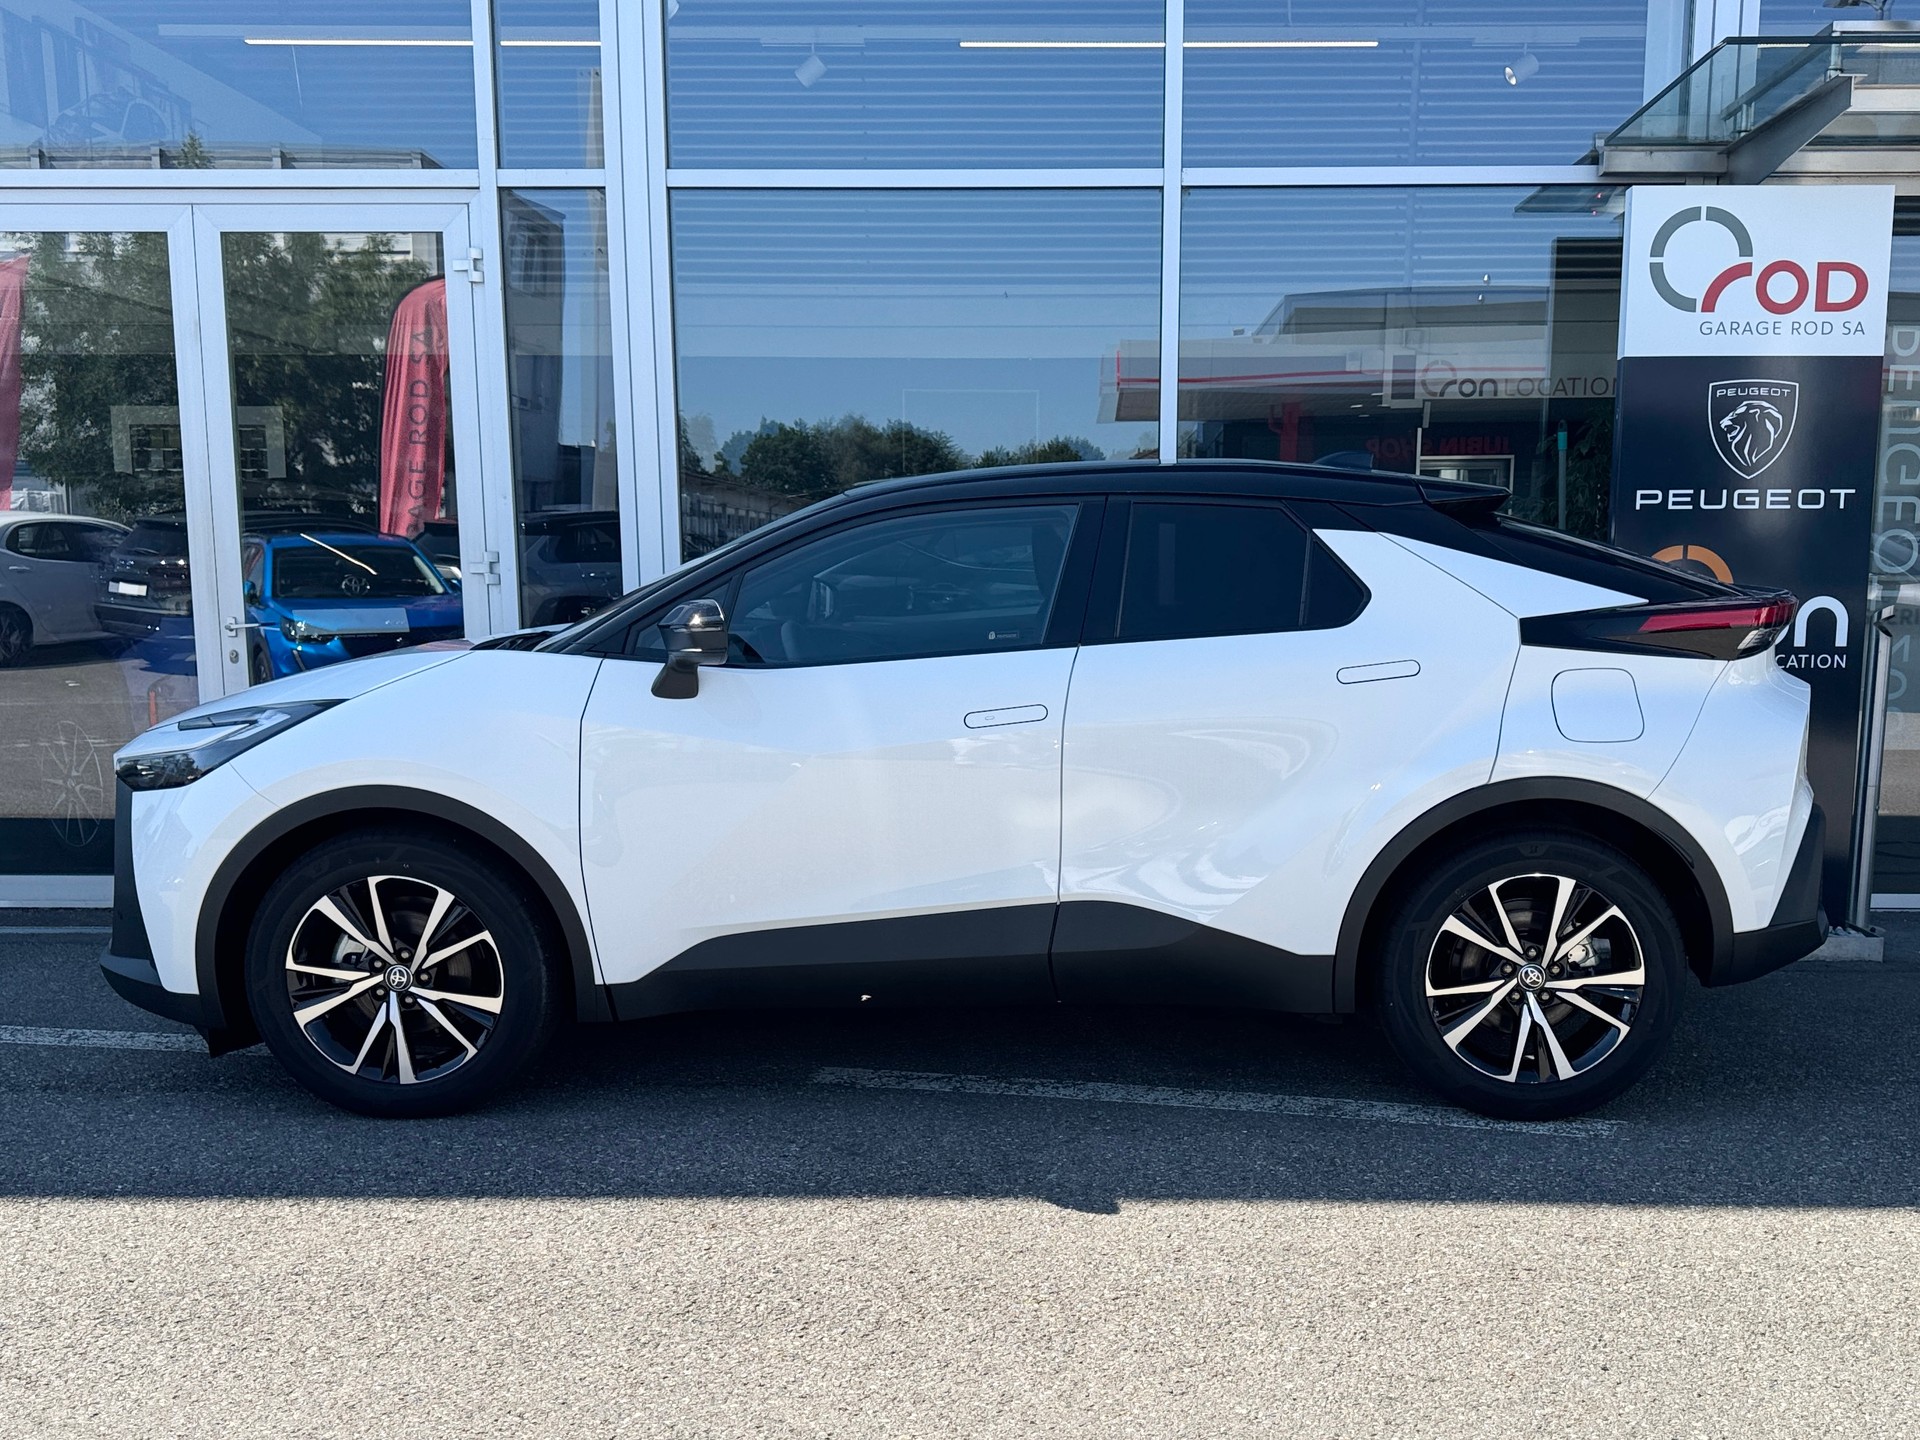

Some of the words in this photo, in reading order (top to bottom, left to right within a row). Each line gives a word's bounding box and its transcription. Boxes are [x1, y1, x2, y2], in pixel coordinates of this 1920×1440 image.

[1699, 320, 1783, 336] GARAGE
[1791, 320, 1834, 336] ROD
[1842, 320, 1866, 336] SA
[1716, 387, 1791, 398] PEUGEOT
[409, 379, 429, 446] ROD
[1635, 489, 1857, 510] PEUGEOT
